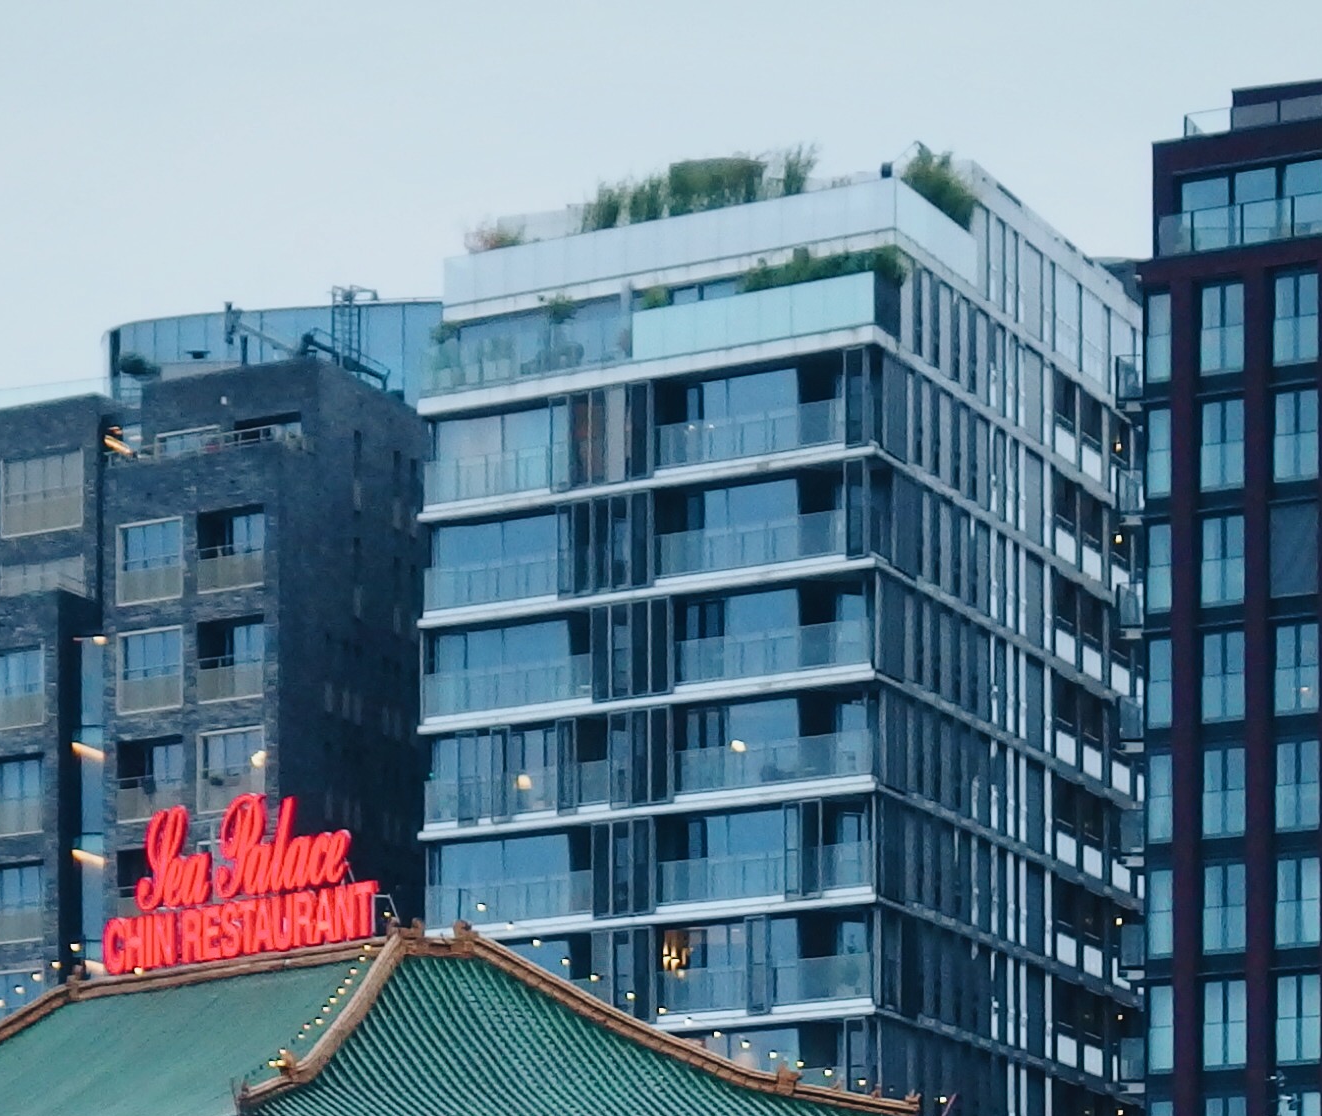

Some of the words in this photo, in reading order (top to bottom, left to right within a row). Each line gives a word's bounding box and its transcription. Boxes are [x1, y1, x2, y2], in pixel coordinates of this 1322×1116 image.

[216, 792, 352, 899] Palace
[102, 916, 176, 975] CHIN
[179, 879, 379, 964] RESTAURANT
